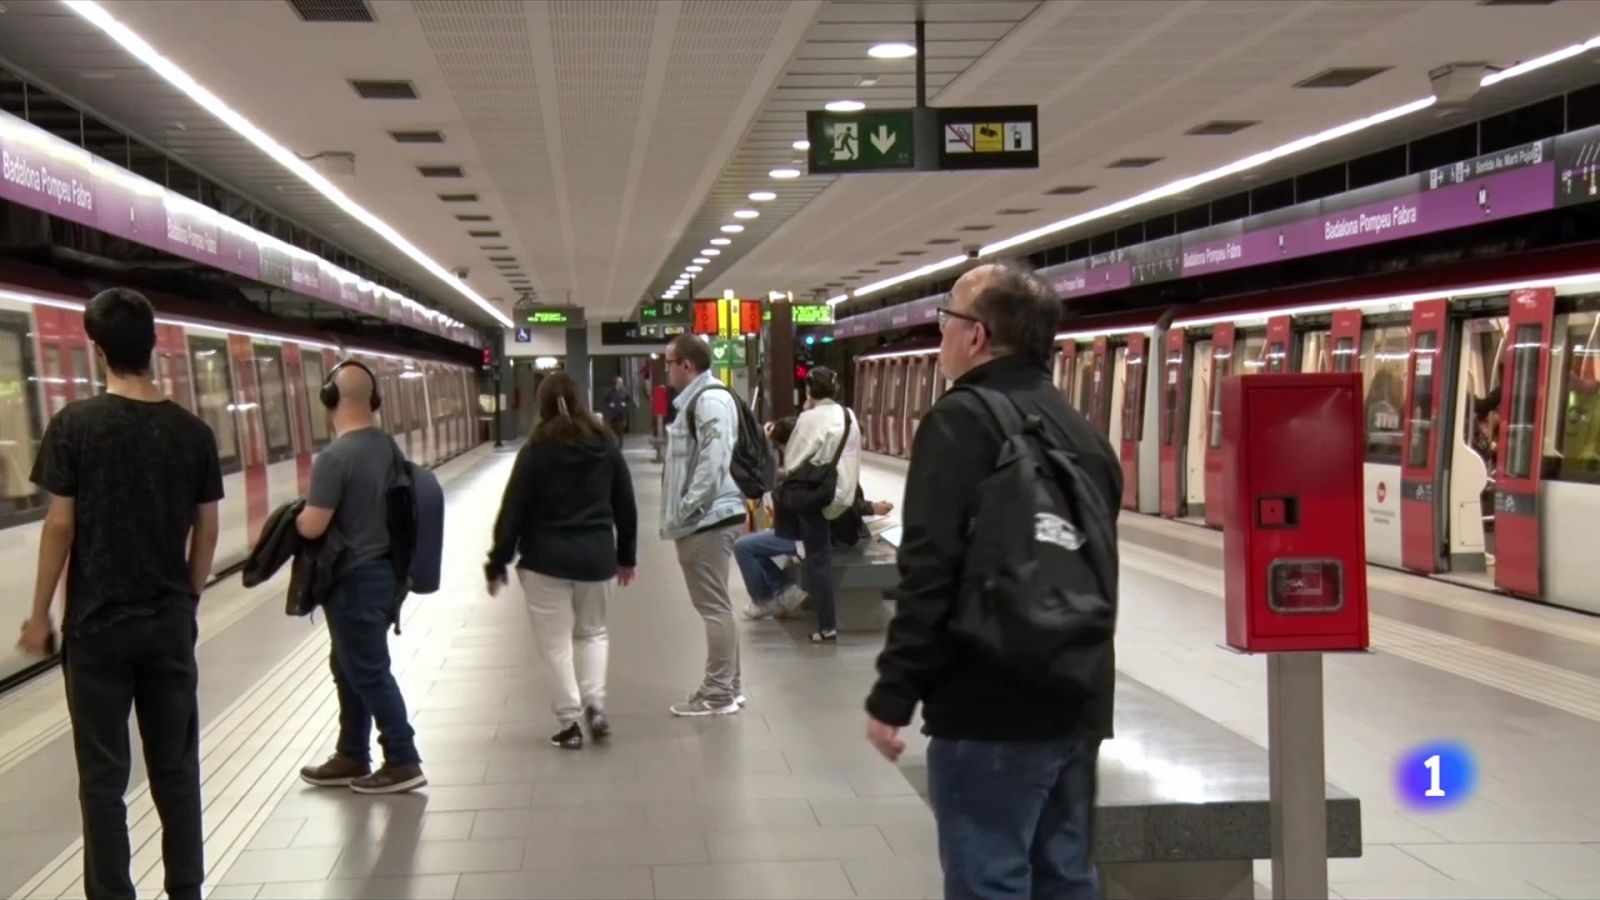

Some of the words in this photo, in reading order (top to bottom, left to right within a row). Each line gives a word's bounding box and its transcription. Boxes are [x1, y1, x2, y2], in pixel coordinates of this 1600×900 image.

[3, 149, 40, 192] Badalona
[41, 166, 71, 205] Pompeu
[71, 178, 92, 210] Fabra
[1325, 220, 1358, 240] Badalona
[1359, 213, 1391, 234] Pompeu
[1392, 205, 1417, 226] Fabra
[1183, 252, 1206, 268] Badalona
[1206, 247, 1226, 265] Pompeu
[1226, 242, 1241, 259] Fabra
